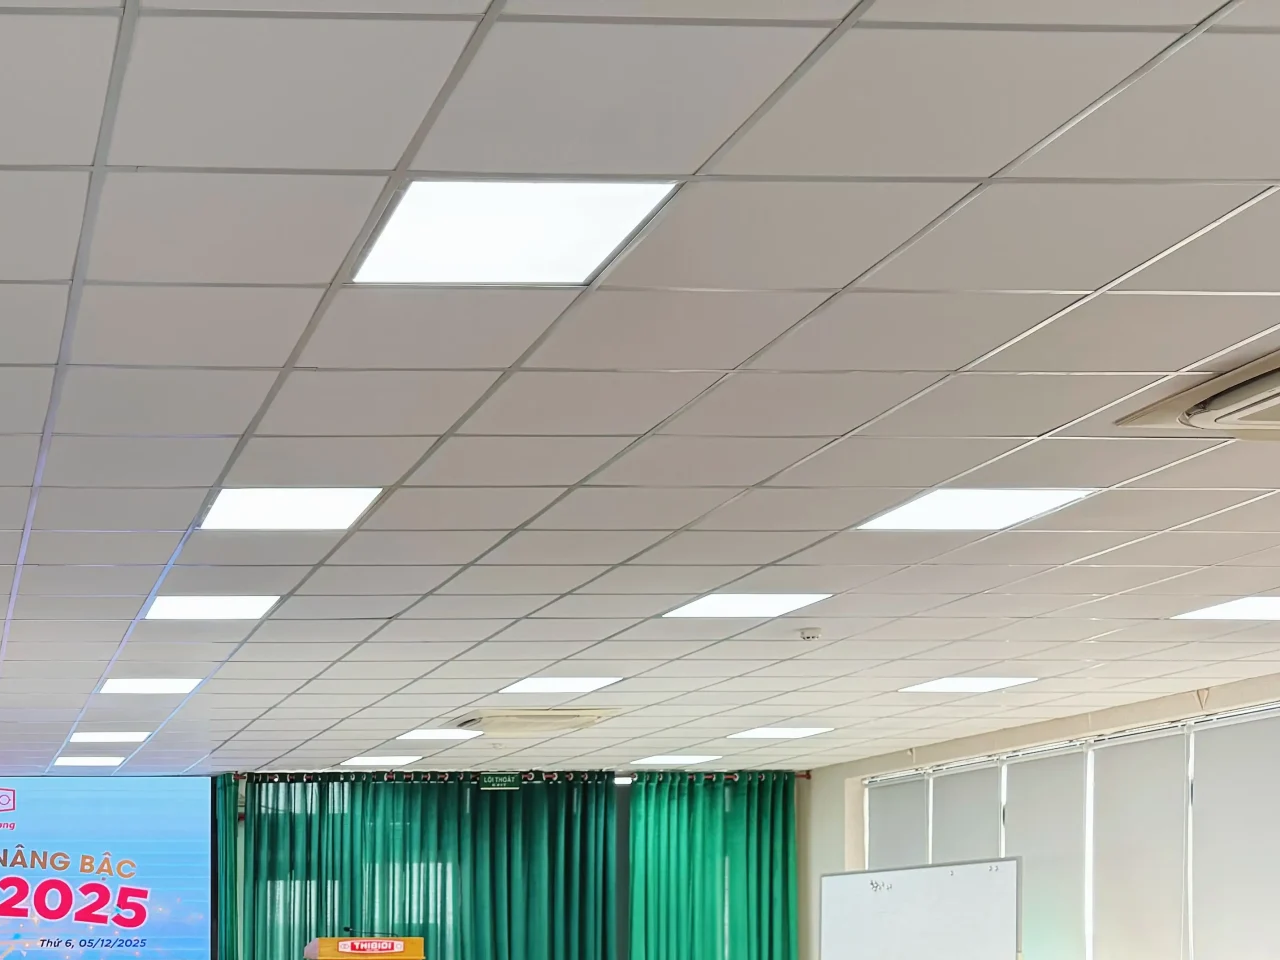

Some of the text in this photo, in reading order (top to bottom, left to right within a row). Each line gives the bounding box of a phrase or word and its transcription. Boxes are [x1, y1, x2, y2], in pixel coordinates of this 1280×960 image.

[79, 851, 137, 881] BẬC
[39, 938, 147, 949] Thứ 6, 05/12/2025
